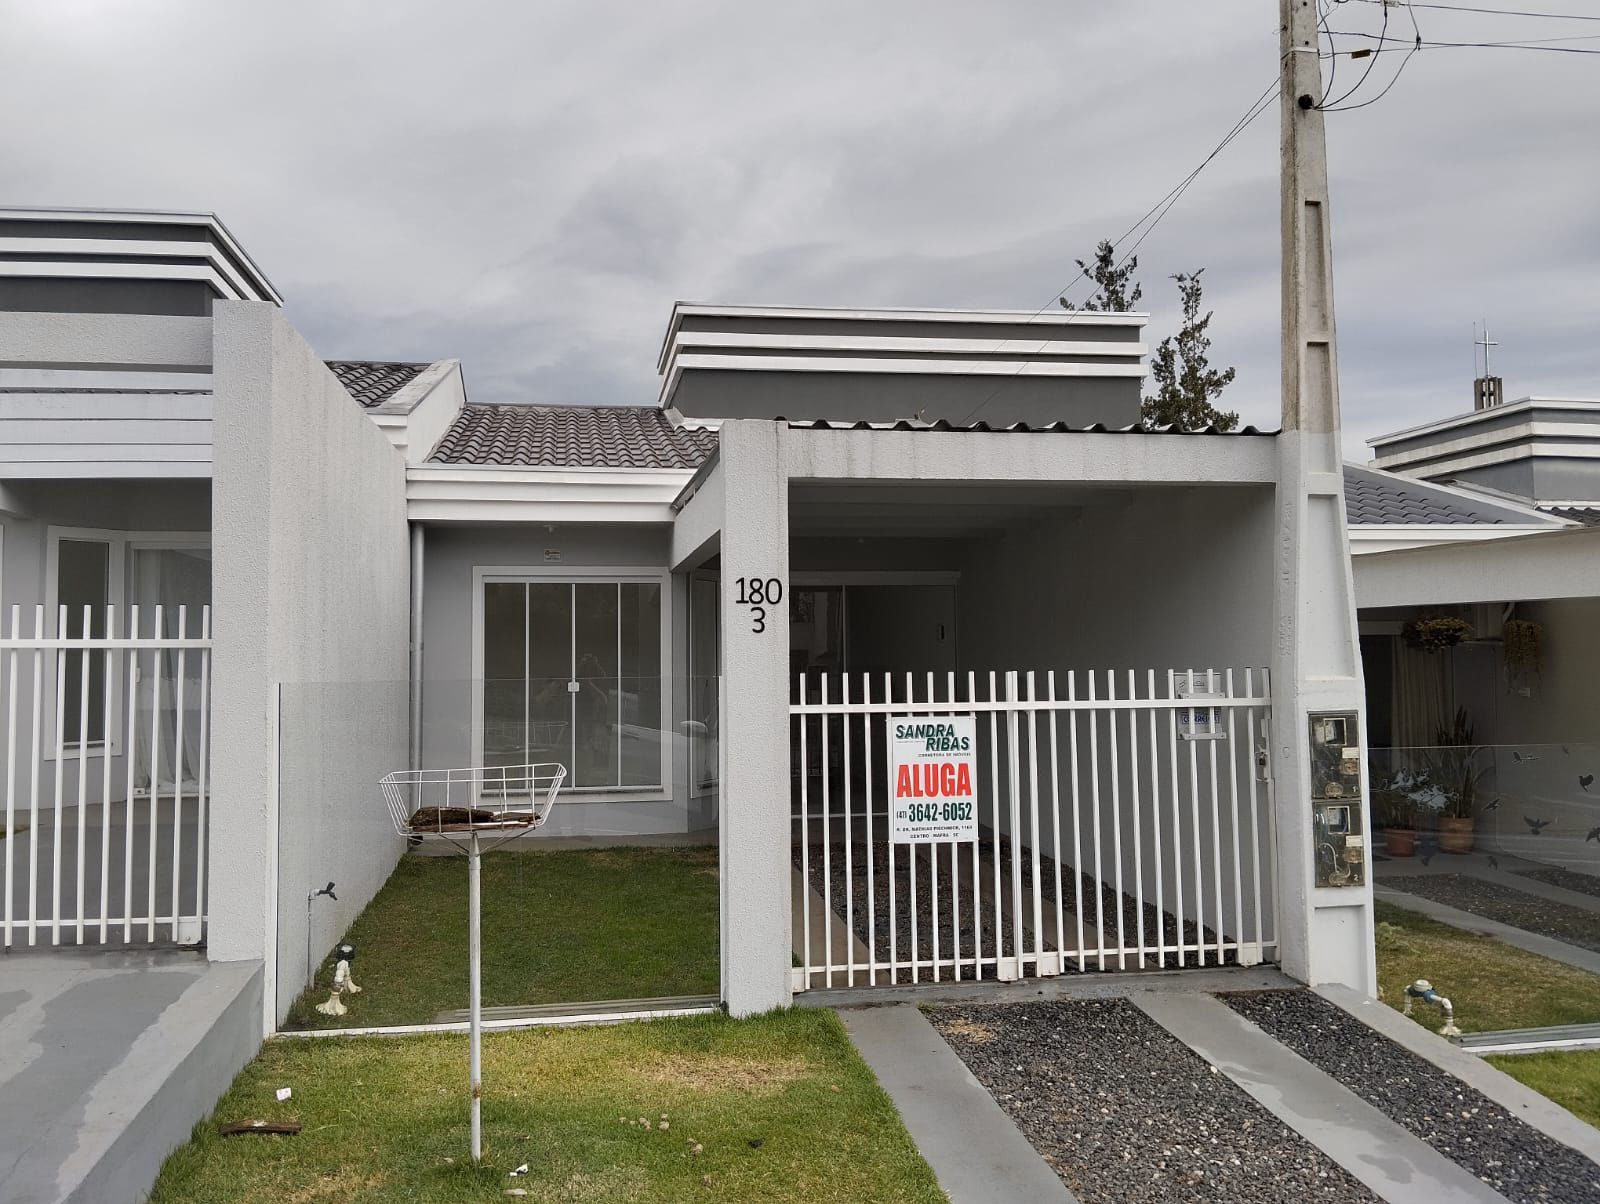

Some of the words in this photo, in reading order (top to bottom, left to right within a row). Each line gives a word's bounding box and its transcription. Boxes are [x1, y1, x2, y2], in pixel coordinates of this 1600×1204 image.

[735, 577, 783, 605] 180
[750, 606, 766, 634] 3
[895, 723, 955, 740] SANDRA
[925, 736, 971, 752] RIBAS
[896, 762, 973, 798] ALUGA
[908, 802, 973, 822] 3642-6052
[1353, 874, 1359, 882] 2
